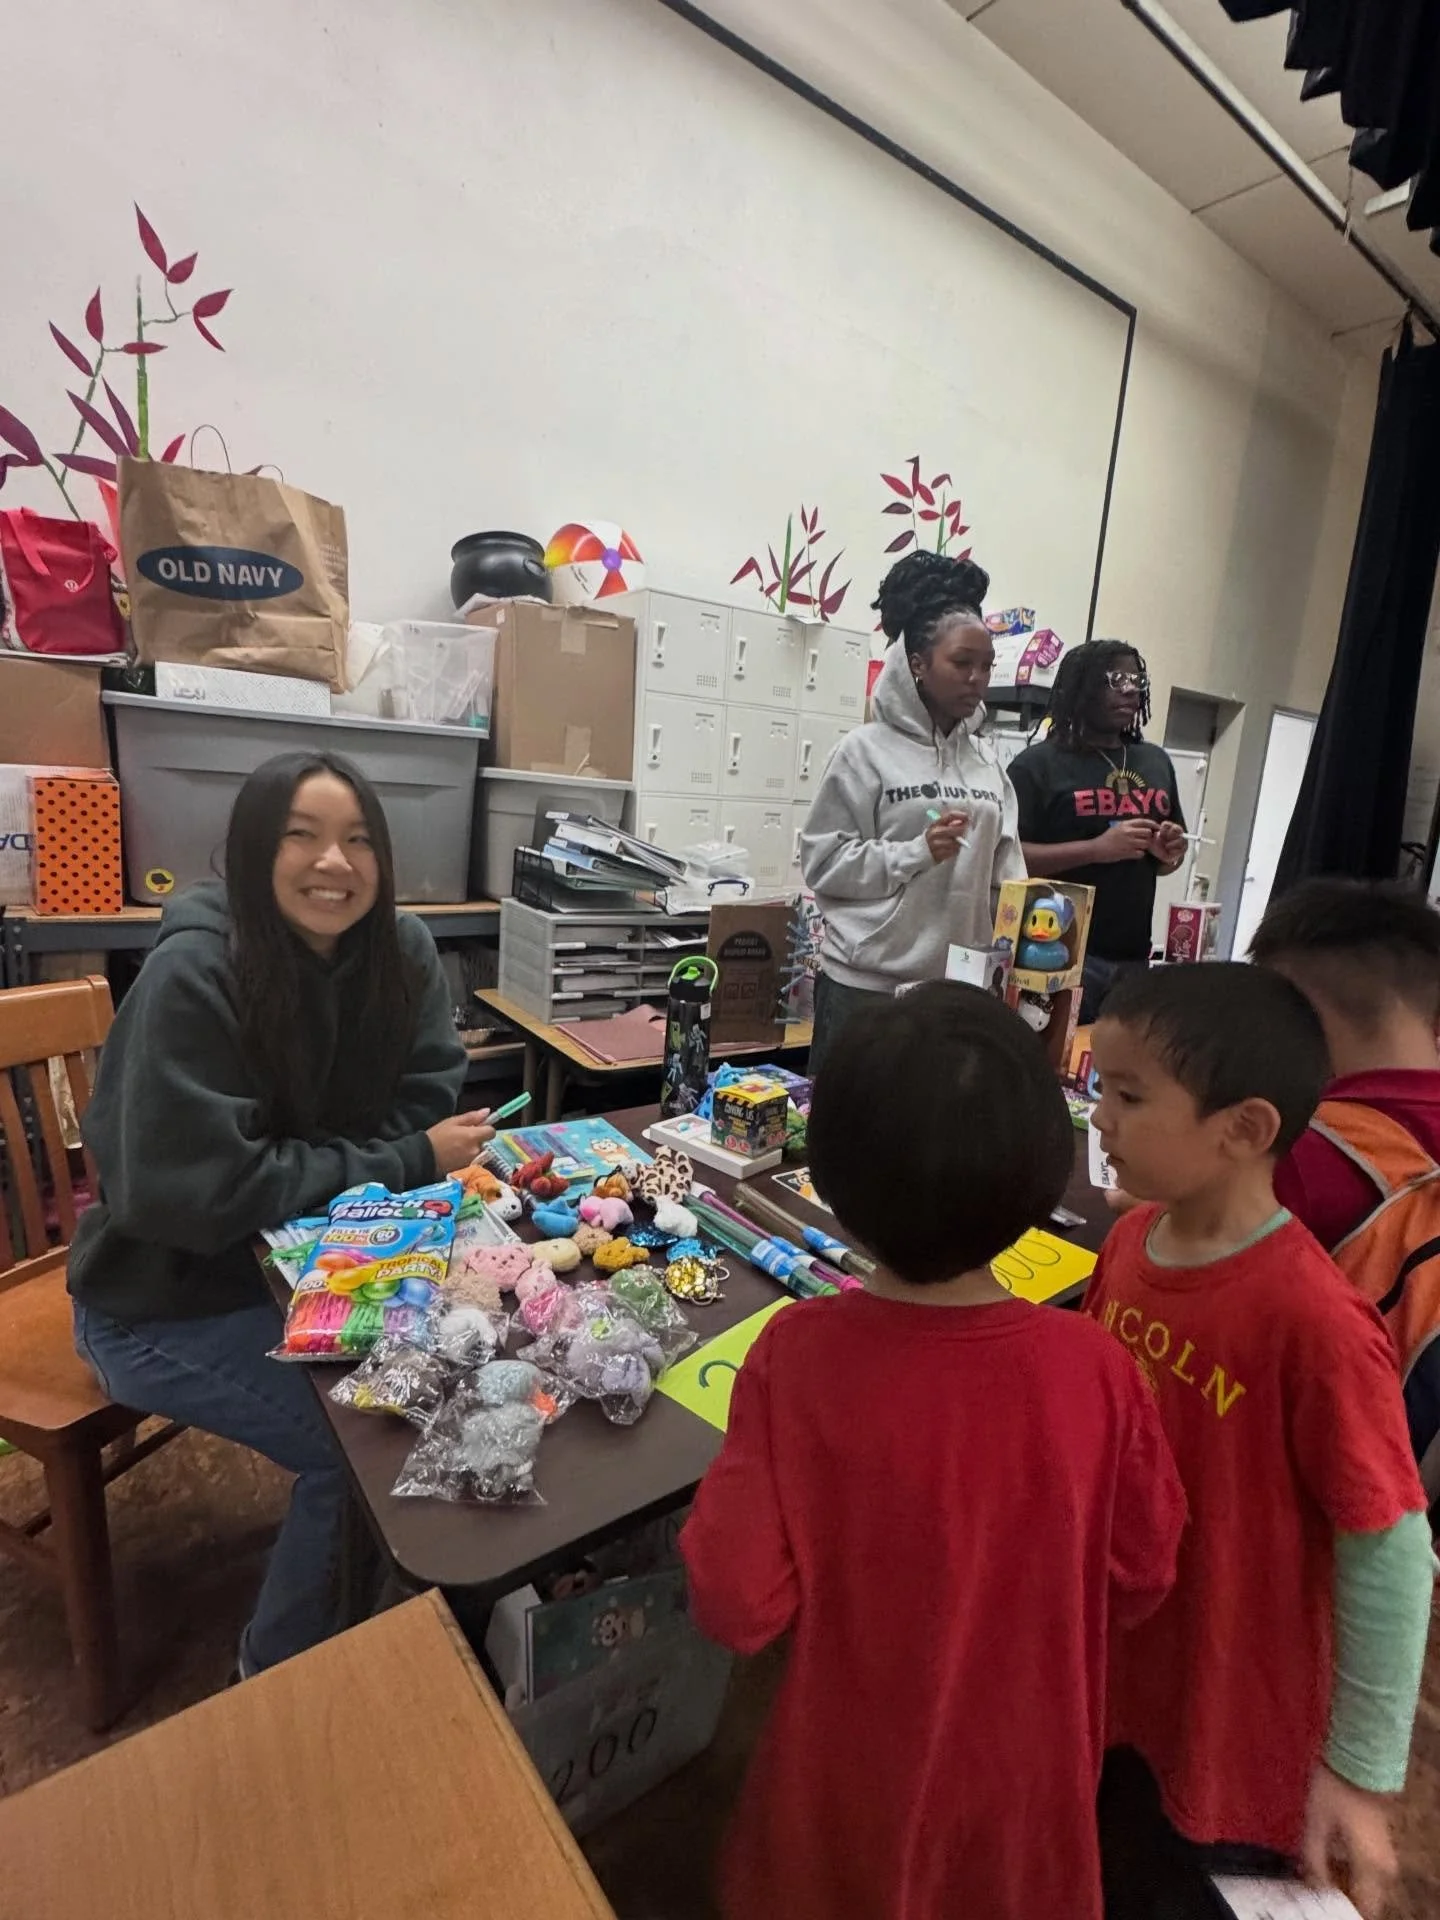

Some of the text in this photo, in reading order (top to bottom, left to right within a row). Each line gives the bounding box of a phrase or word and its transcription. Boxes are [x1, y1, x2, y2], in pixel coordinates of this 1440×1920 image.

[158, 557, 284, 588] OLD NAVY
[885, 785, 921, 804] THE
